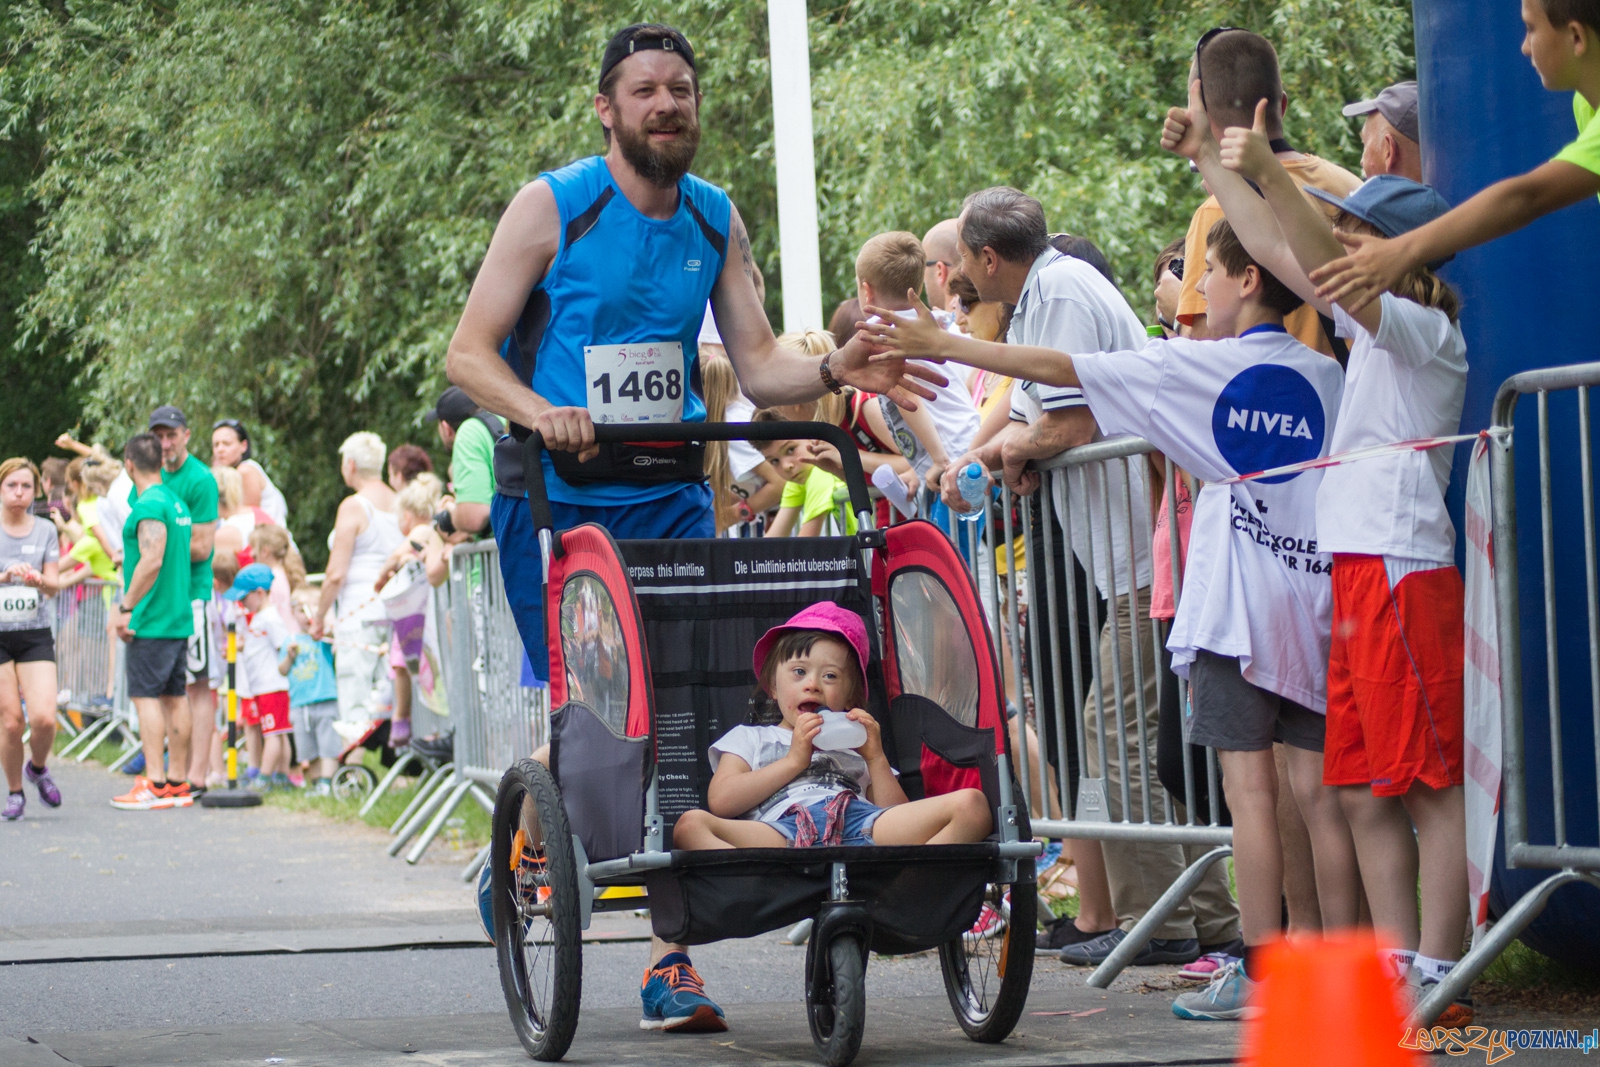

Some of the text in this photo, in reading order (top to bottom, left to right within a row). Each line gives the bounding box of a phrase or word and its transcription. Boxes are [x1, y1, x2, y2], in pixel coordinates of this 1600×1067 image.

[593, 369, 682, 404] 1468
[1227, 406, 1313, 440] NIVEA
[657, 563, 673, 578] this
[674, 562, 705, 577] limitline
[734, 556, 857, 575] Die Limitlinie nicht uberschreiten
[1304, 558, 1333, 577] 164
